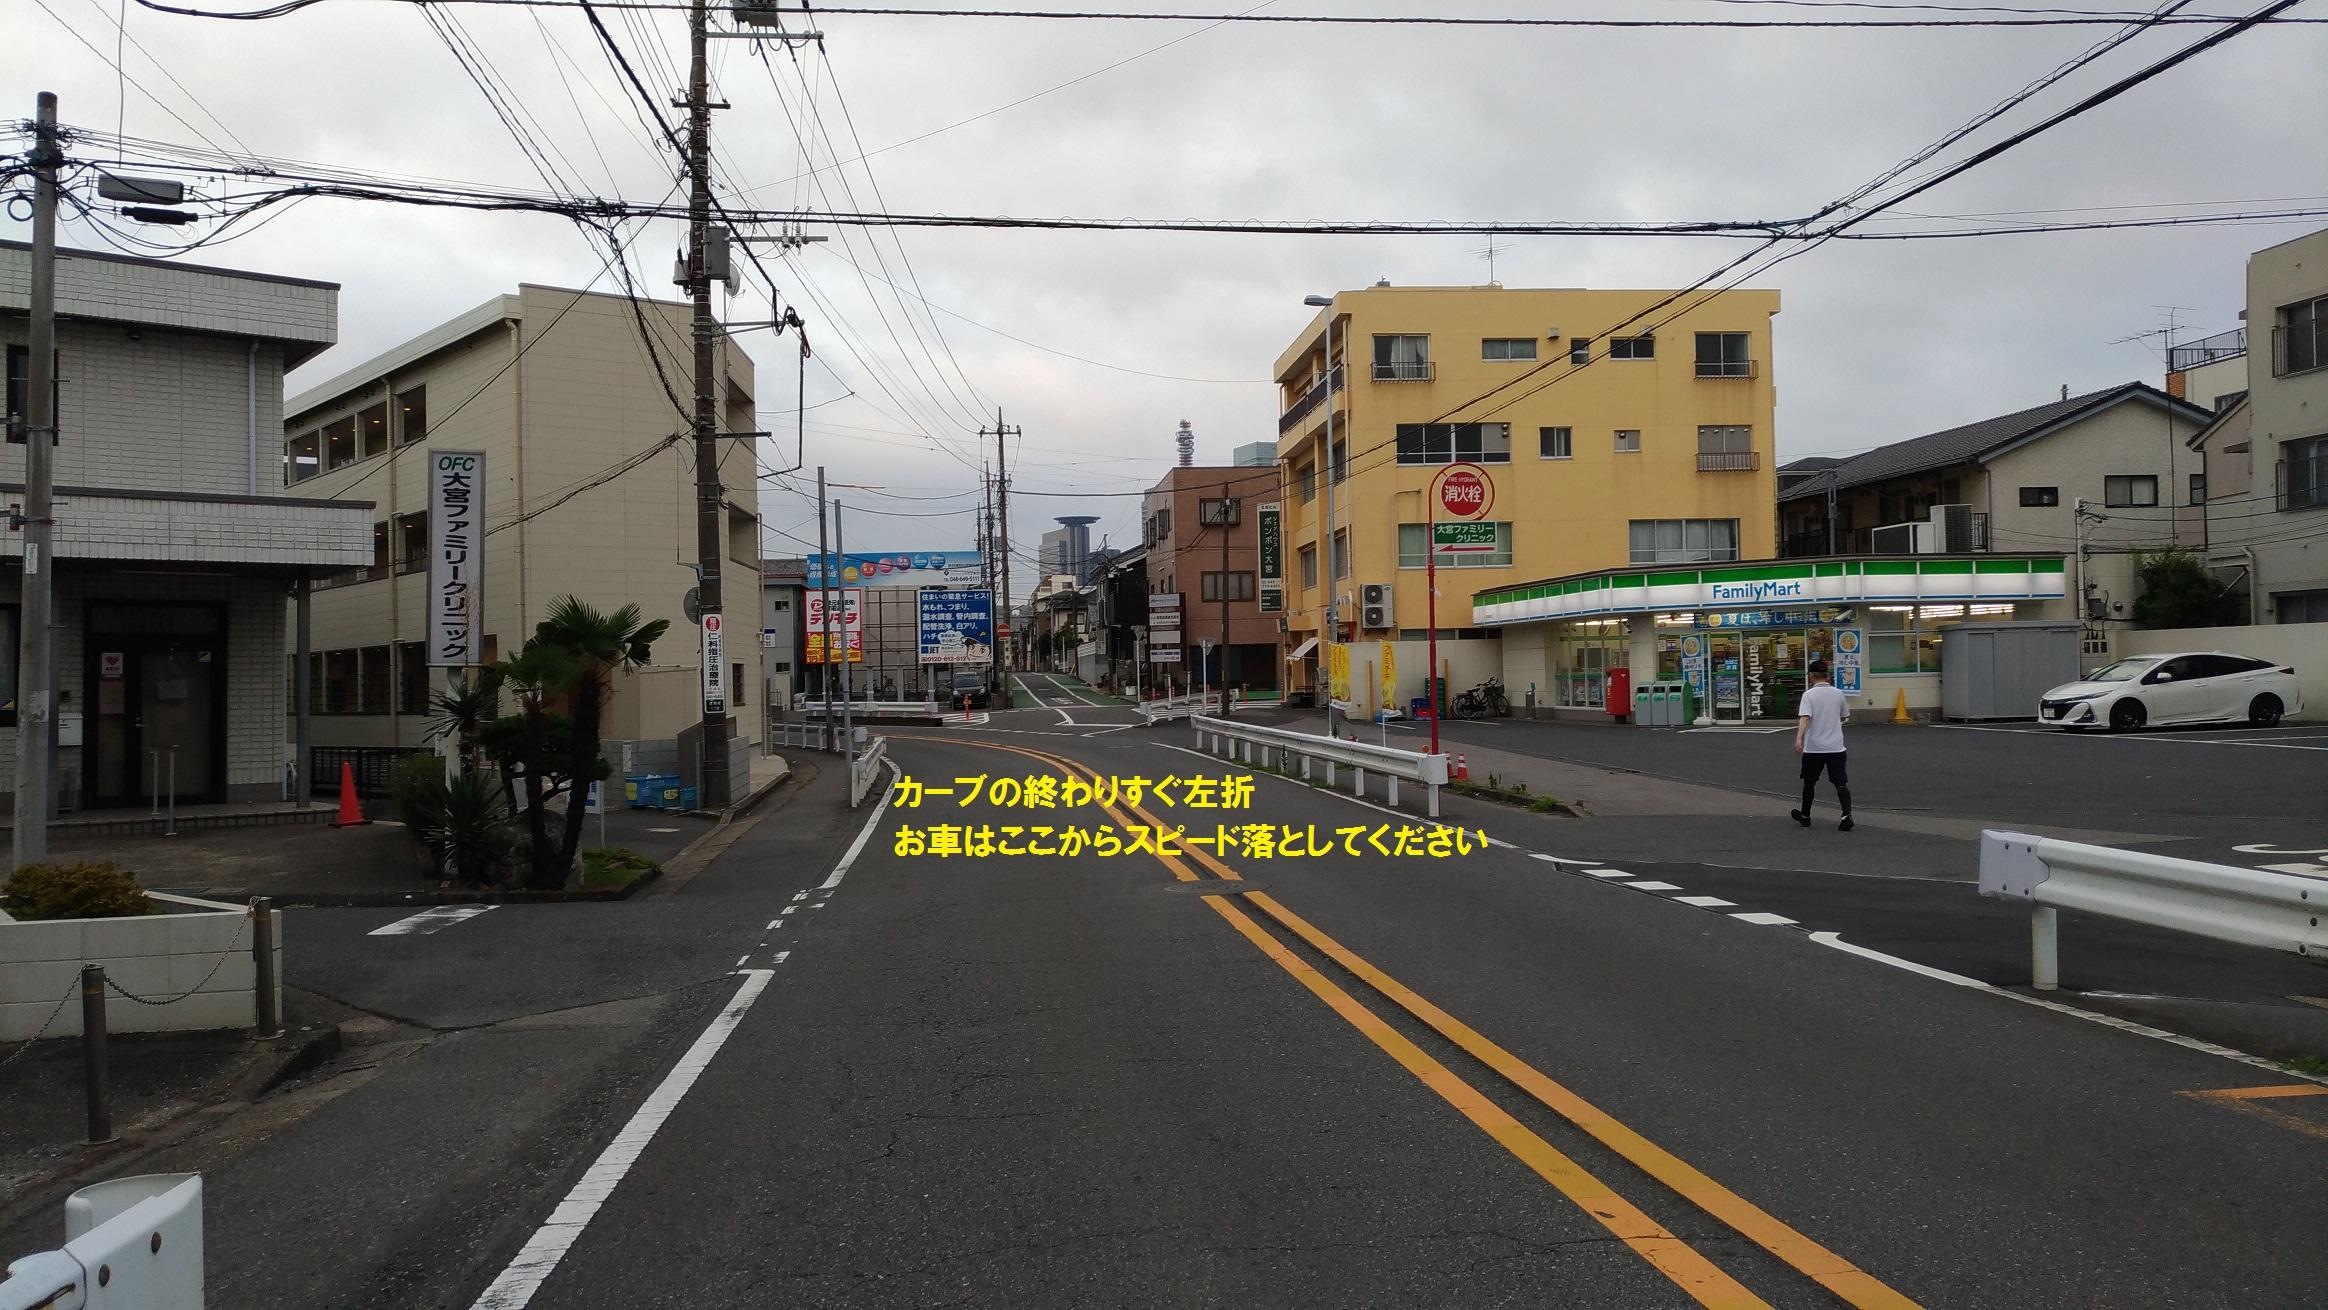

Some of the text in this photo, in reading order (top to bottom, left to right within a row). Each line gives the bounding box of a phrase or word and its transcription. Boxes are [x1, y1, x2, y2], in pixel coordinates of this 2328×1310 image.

[438, 456, 475, 472] OFC
[1444, 485, 1482, 503] 消火栓
[1436, 524, 1494, 535] 大宮ファミリー
[1455, 534, 1494, 543] クリニック
[441, 471, 472, 659] 大宮ファミリークリニック
[1712, 581, 1801, 601] FamilyMart
